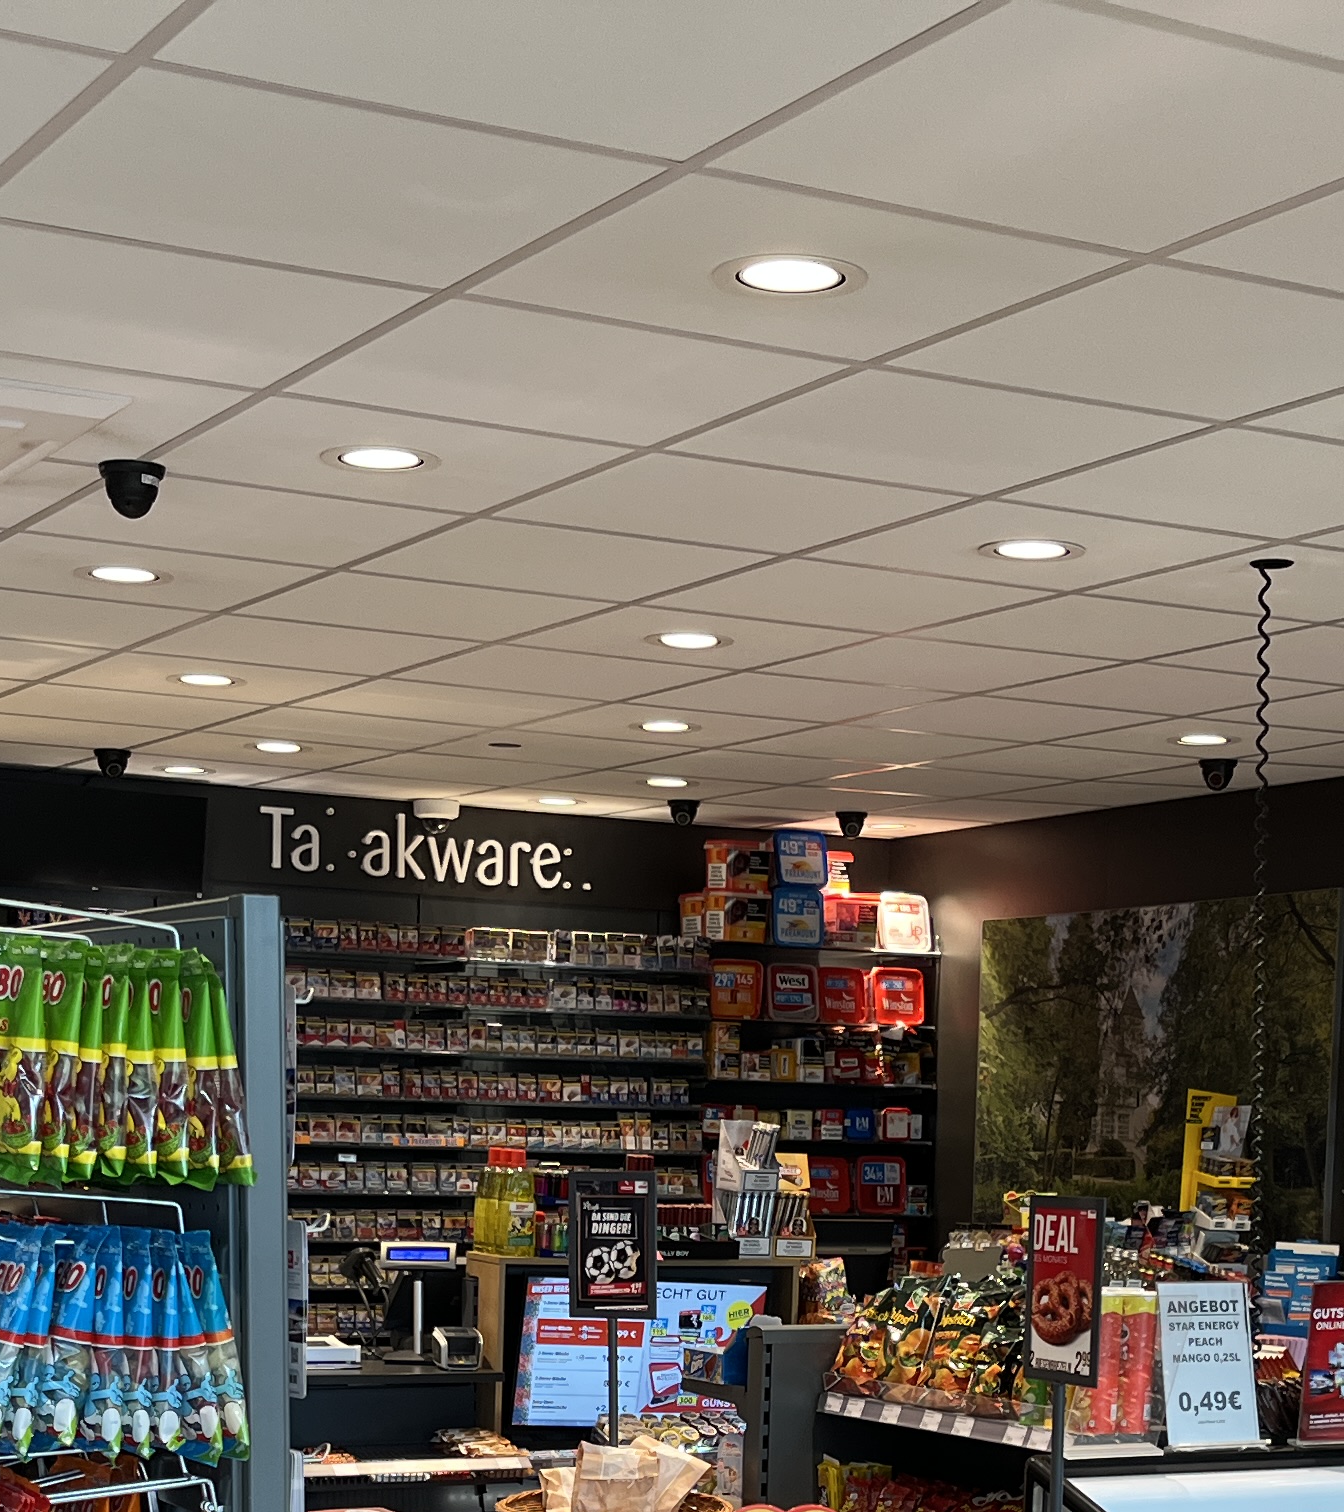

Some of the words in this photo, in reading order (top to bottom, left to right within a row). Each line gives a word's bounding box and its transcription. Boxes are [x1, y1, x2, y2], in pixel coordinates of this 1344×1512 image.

[778, 976, 807, 987] West
[591, 1222, 632, 1235] DINGER!
[1034, 1215, 1079, 1254] DEAL
[1044, 1255, 1068, 1265] MONATS
[657, 1288, 692, 1299] ECHT
[697, 1289, 727, 1301] GUT
[728, 1308, 750, 1319] HIER
[1167, 1299, 1239, 1315] ANGEBOT
[1168, 1321, 1196, 1331] STAR
[1198, 1320, 1239, 1331] ENERGY
[1188, 1337, 1223, 1348] PEACH
[1172, 1352, 1210, 1364] MANGO
[1212, 1352, 1241, 1365] 0,25L
[1178, 1390, 1242, 1416] 0,49€
